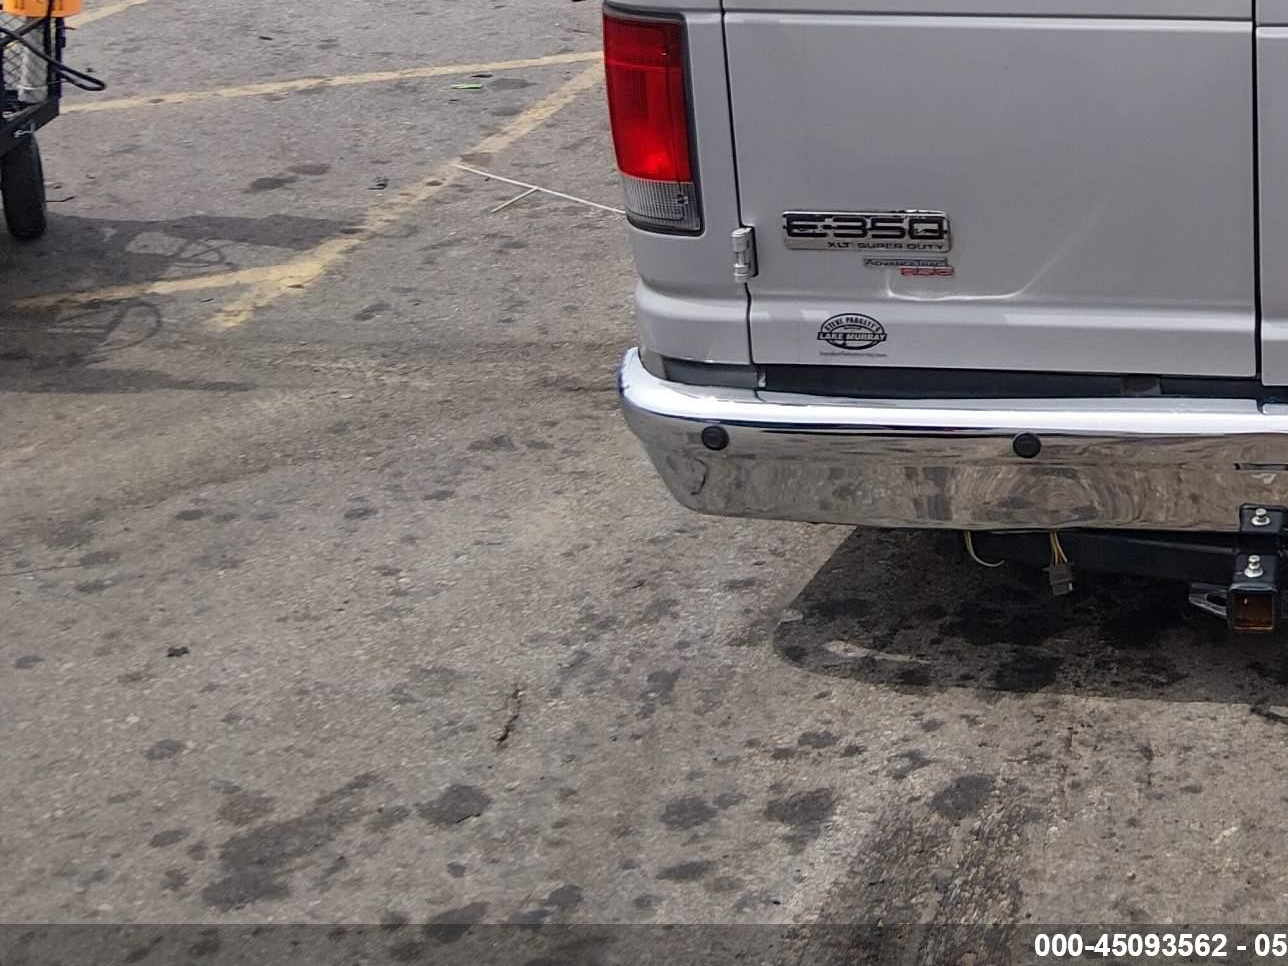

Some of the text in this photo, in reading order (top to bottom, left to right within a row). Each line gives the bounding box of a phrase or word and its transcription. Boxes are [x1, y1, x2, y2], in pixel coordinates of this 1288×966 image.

[786, 216, 945, 239] E-350
[819, 332, 885, 341] LAKE MURRAY
